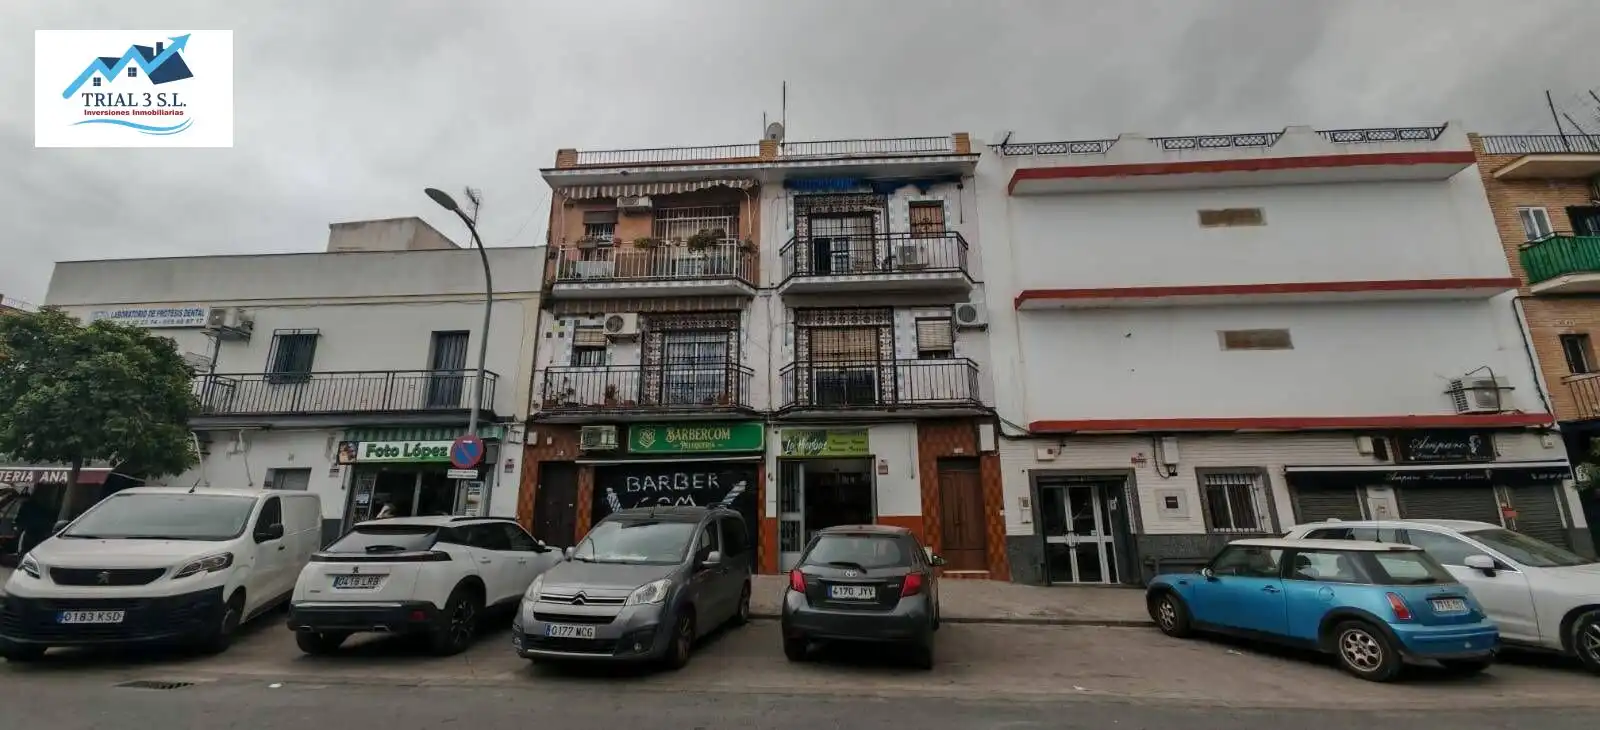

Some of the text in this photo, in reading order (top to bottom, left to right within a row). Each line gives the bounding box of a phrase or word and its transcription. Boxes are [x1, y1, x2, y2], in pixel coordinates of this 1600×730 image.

[1408, 435, 1465, 453] Amparo
[365, 442, 448, 460] Foto López
[39, 471, 68, 483] ANA
[626, 472, 720, 492] BARBER
[833, 587, 854, 596] 4170
[65, 611, 120, 622] 0183 KSD
[551, 625, 575, 636] 0177
